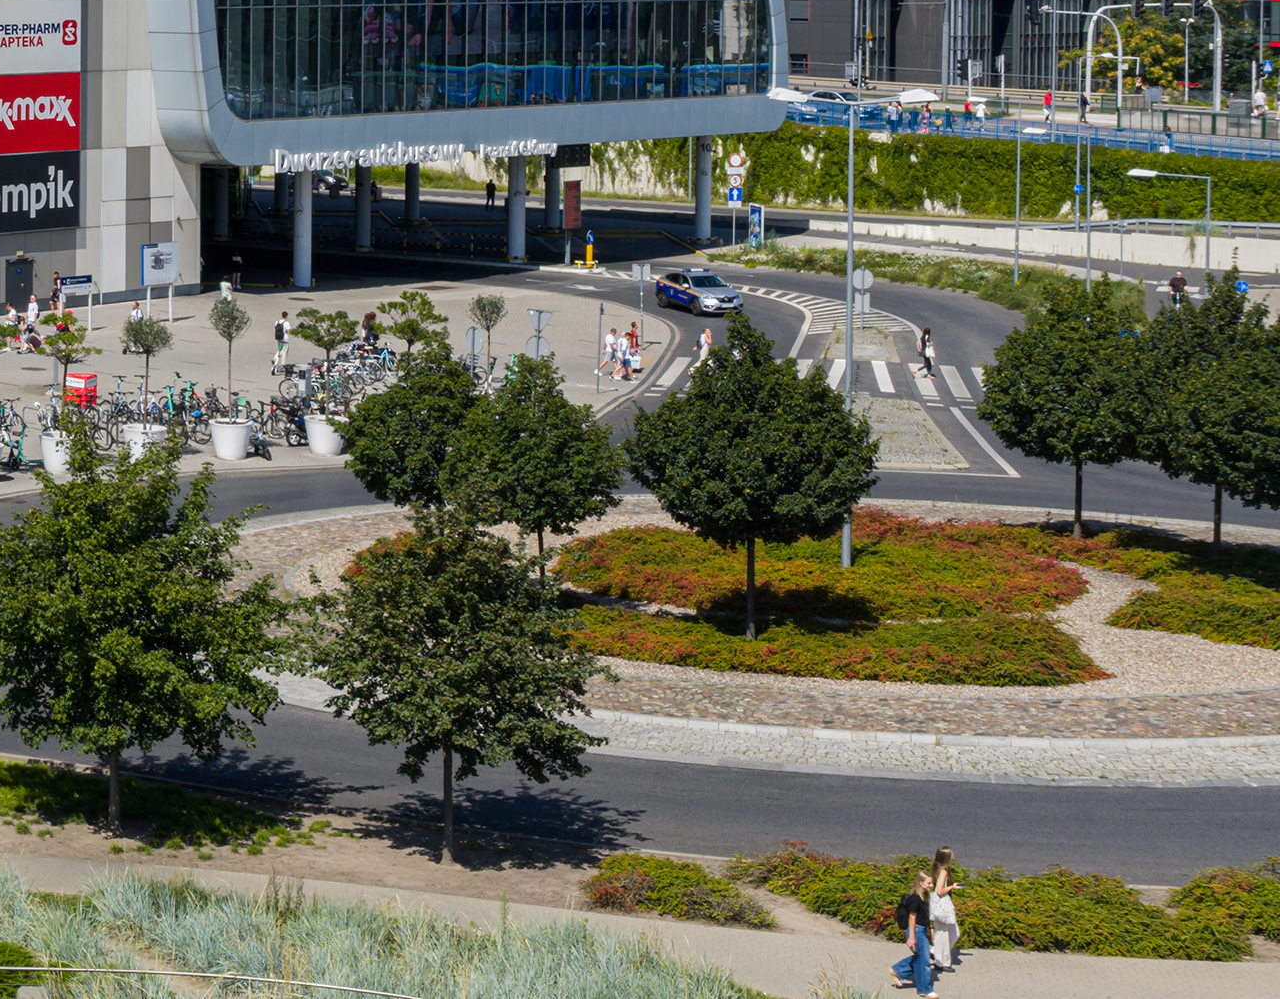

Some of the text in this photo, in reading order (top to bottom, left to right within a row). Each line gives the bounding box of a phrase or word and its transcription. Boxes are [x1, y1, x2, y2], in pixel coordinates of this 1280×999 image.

[0, 36, 44, 48] APTEKA
[701, 143, 711, 153] 10
[275, 147, 355, 174] Dworzec
[356, 141, 465, 167] autobusowy
